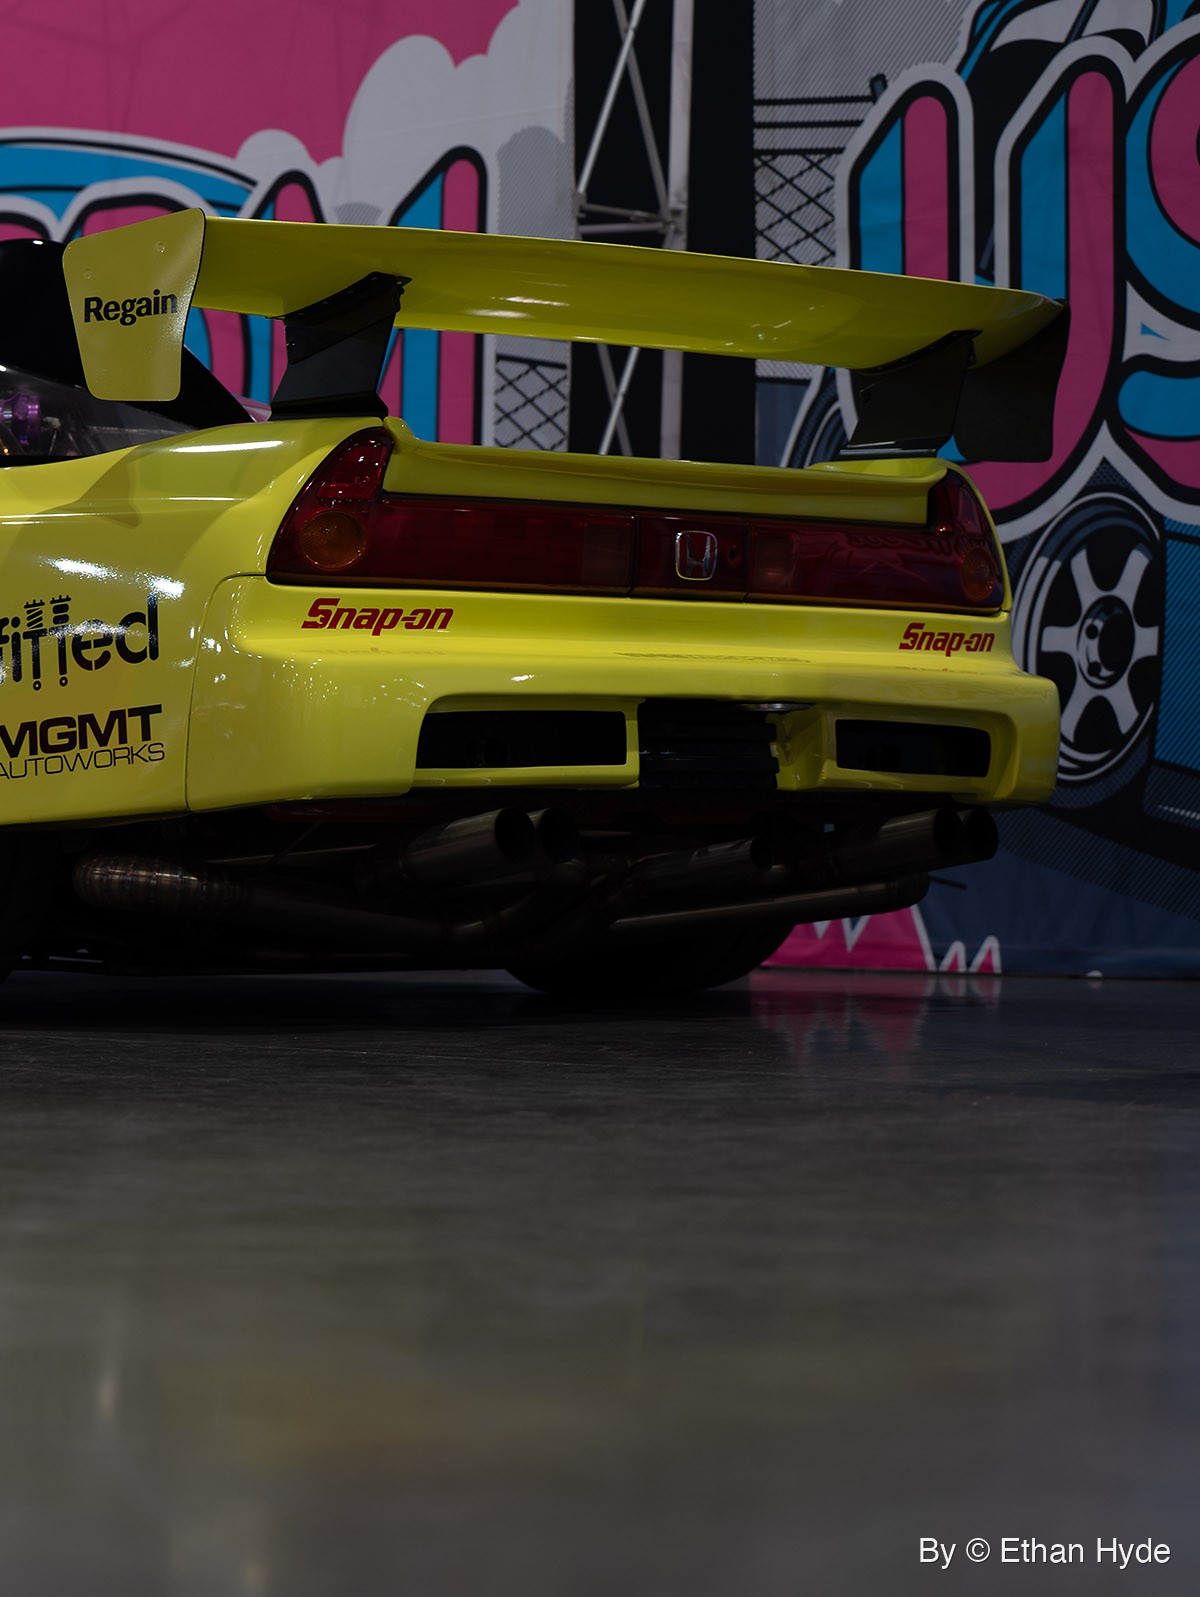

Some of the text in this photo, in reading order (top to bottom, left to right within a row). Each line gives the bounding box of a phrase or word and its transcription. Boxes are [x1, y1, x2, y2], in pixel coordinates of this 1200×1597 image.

[83, 289, 178, 326] Regain
[301, 597, 454, 636] Snap-on
[898, 622, 995, 657] Snap-on
